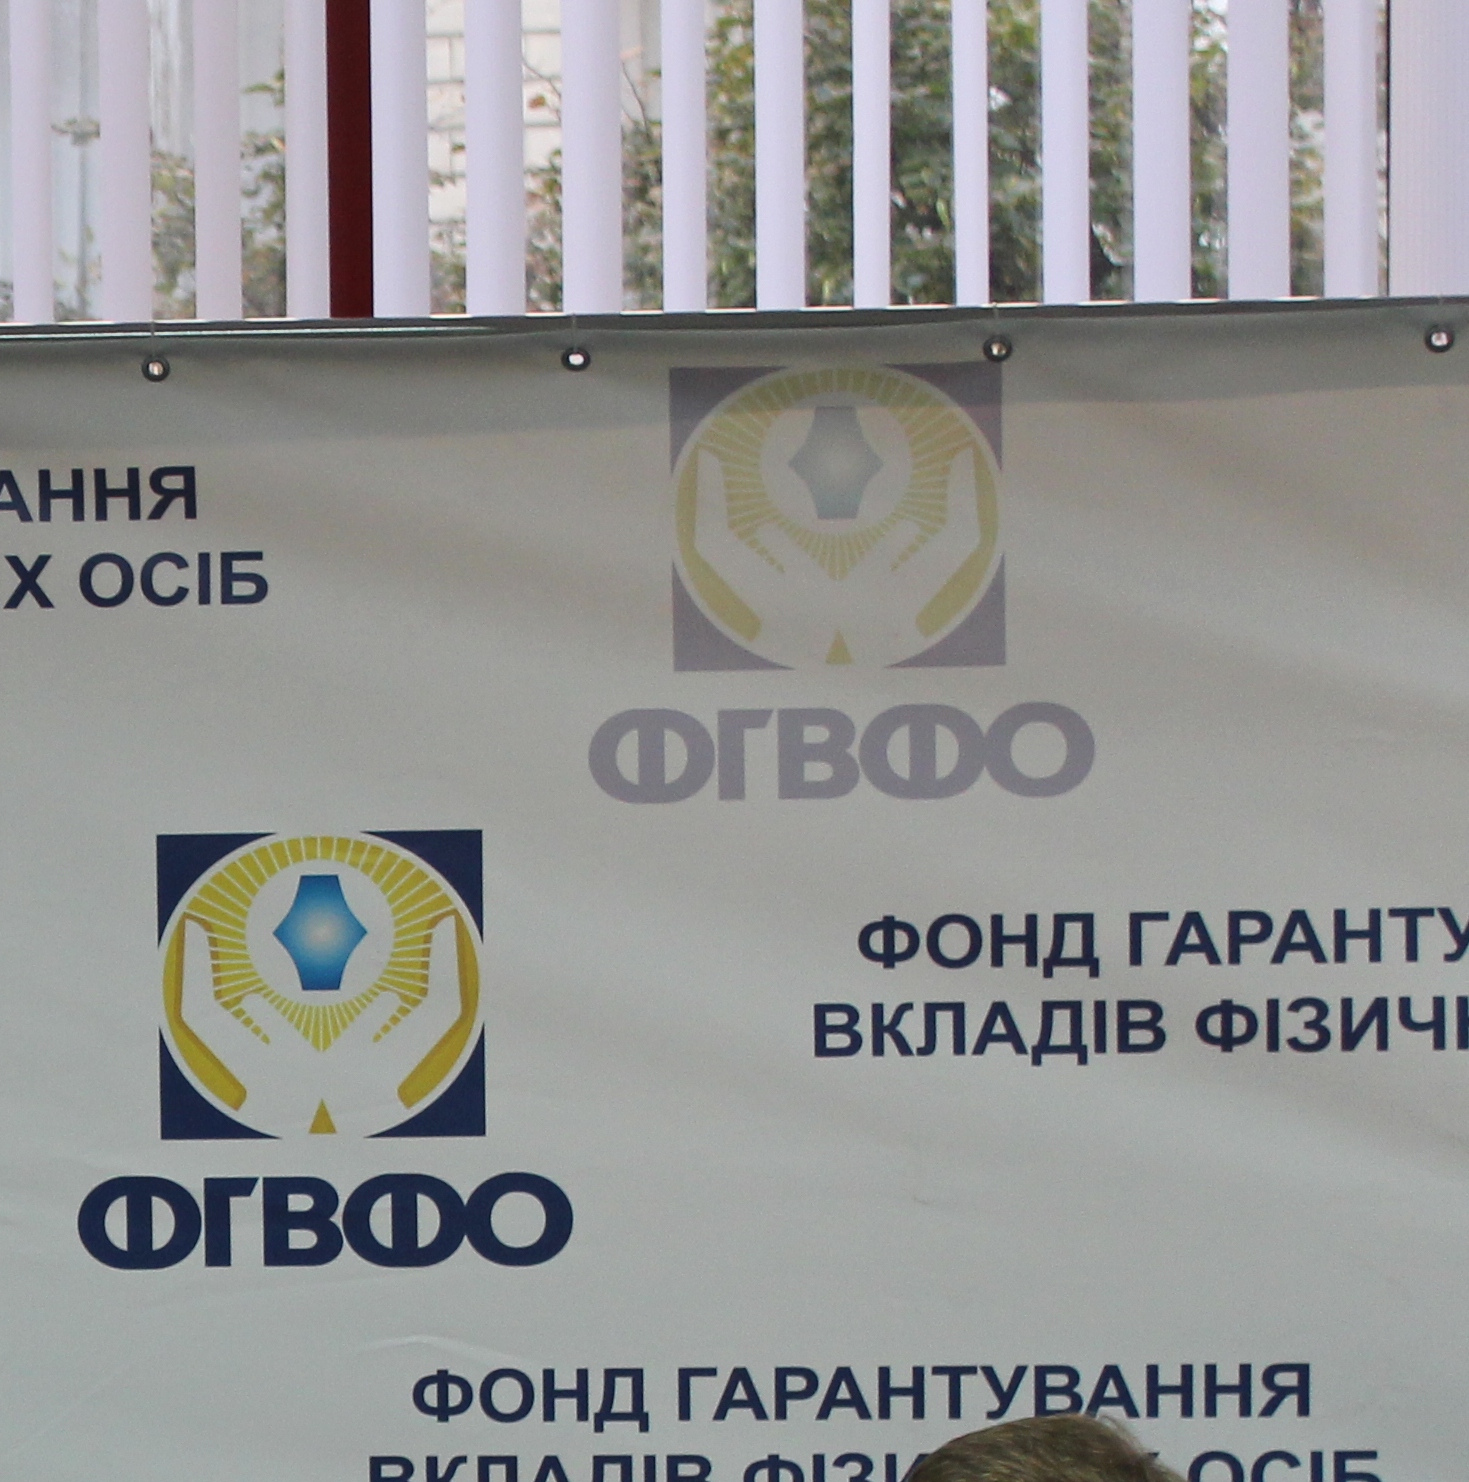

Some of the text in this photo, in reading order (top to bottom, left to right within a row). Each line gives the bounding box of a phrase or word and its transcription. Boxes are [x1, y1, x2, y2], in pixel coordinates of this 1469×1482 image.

[79, 551, 268, 607] ОСІБ
[589, 701, 1095, 804] ФГВФО
[858, 907, 1469, 978] ФОНД ГАРАНТУ
[814, 996, 1469, 1066] ВКЛАДІВ ФІЗИЧ
[78, 1172, 573, 1270] ФГВФО
[413, 1363, 1313, 1433] ФОНД ГАРАНТУВАННЯ
